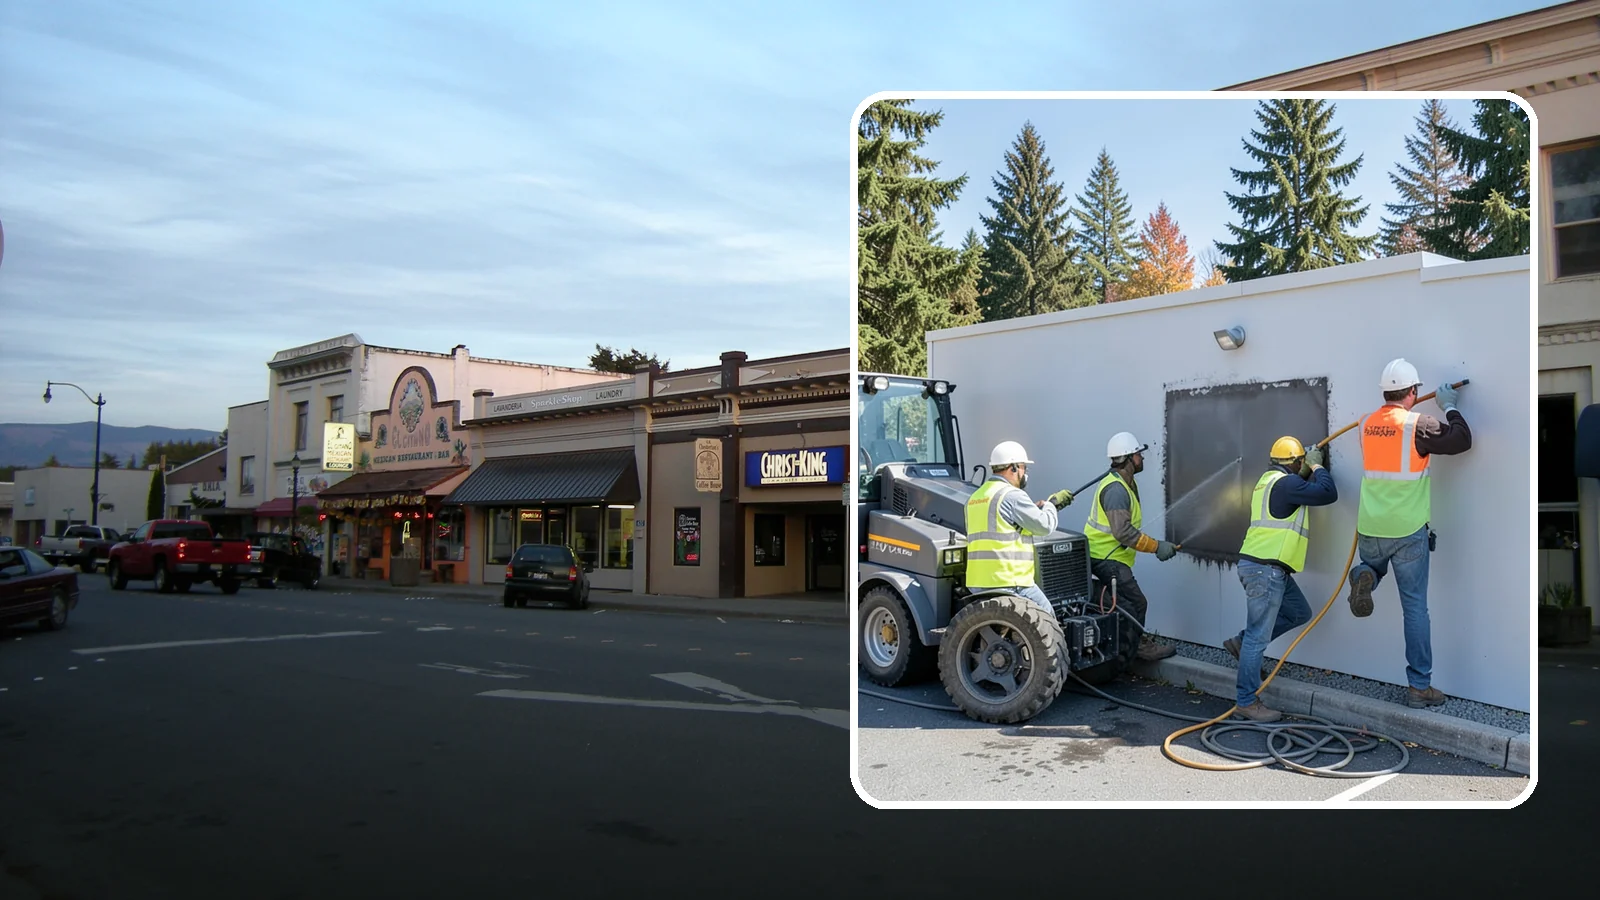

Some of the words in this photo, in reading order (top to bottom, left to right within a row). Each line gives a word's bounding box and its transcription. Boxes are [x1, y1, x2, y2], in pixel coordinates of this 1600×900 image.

[493, 402, 523, 412] LAVANDERIA
[561, 394, 583, 405] Shop
[595, 389, 624, 400] LAUNDRY
[373, 455, 396, 464] MEXICAN
[397, 452, 434, 462] RESTAURANT
[437, 450, 450, 459] BAR
[761, 452, 797, 478] CHRIST
[799, 450, 827, 476] KING
